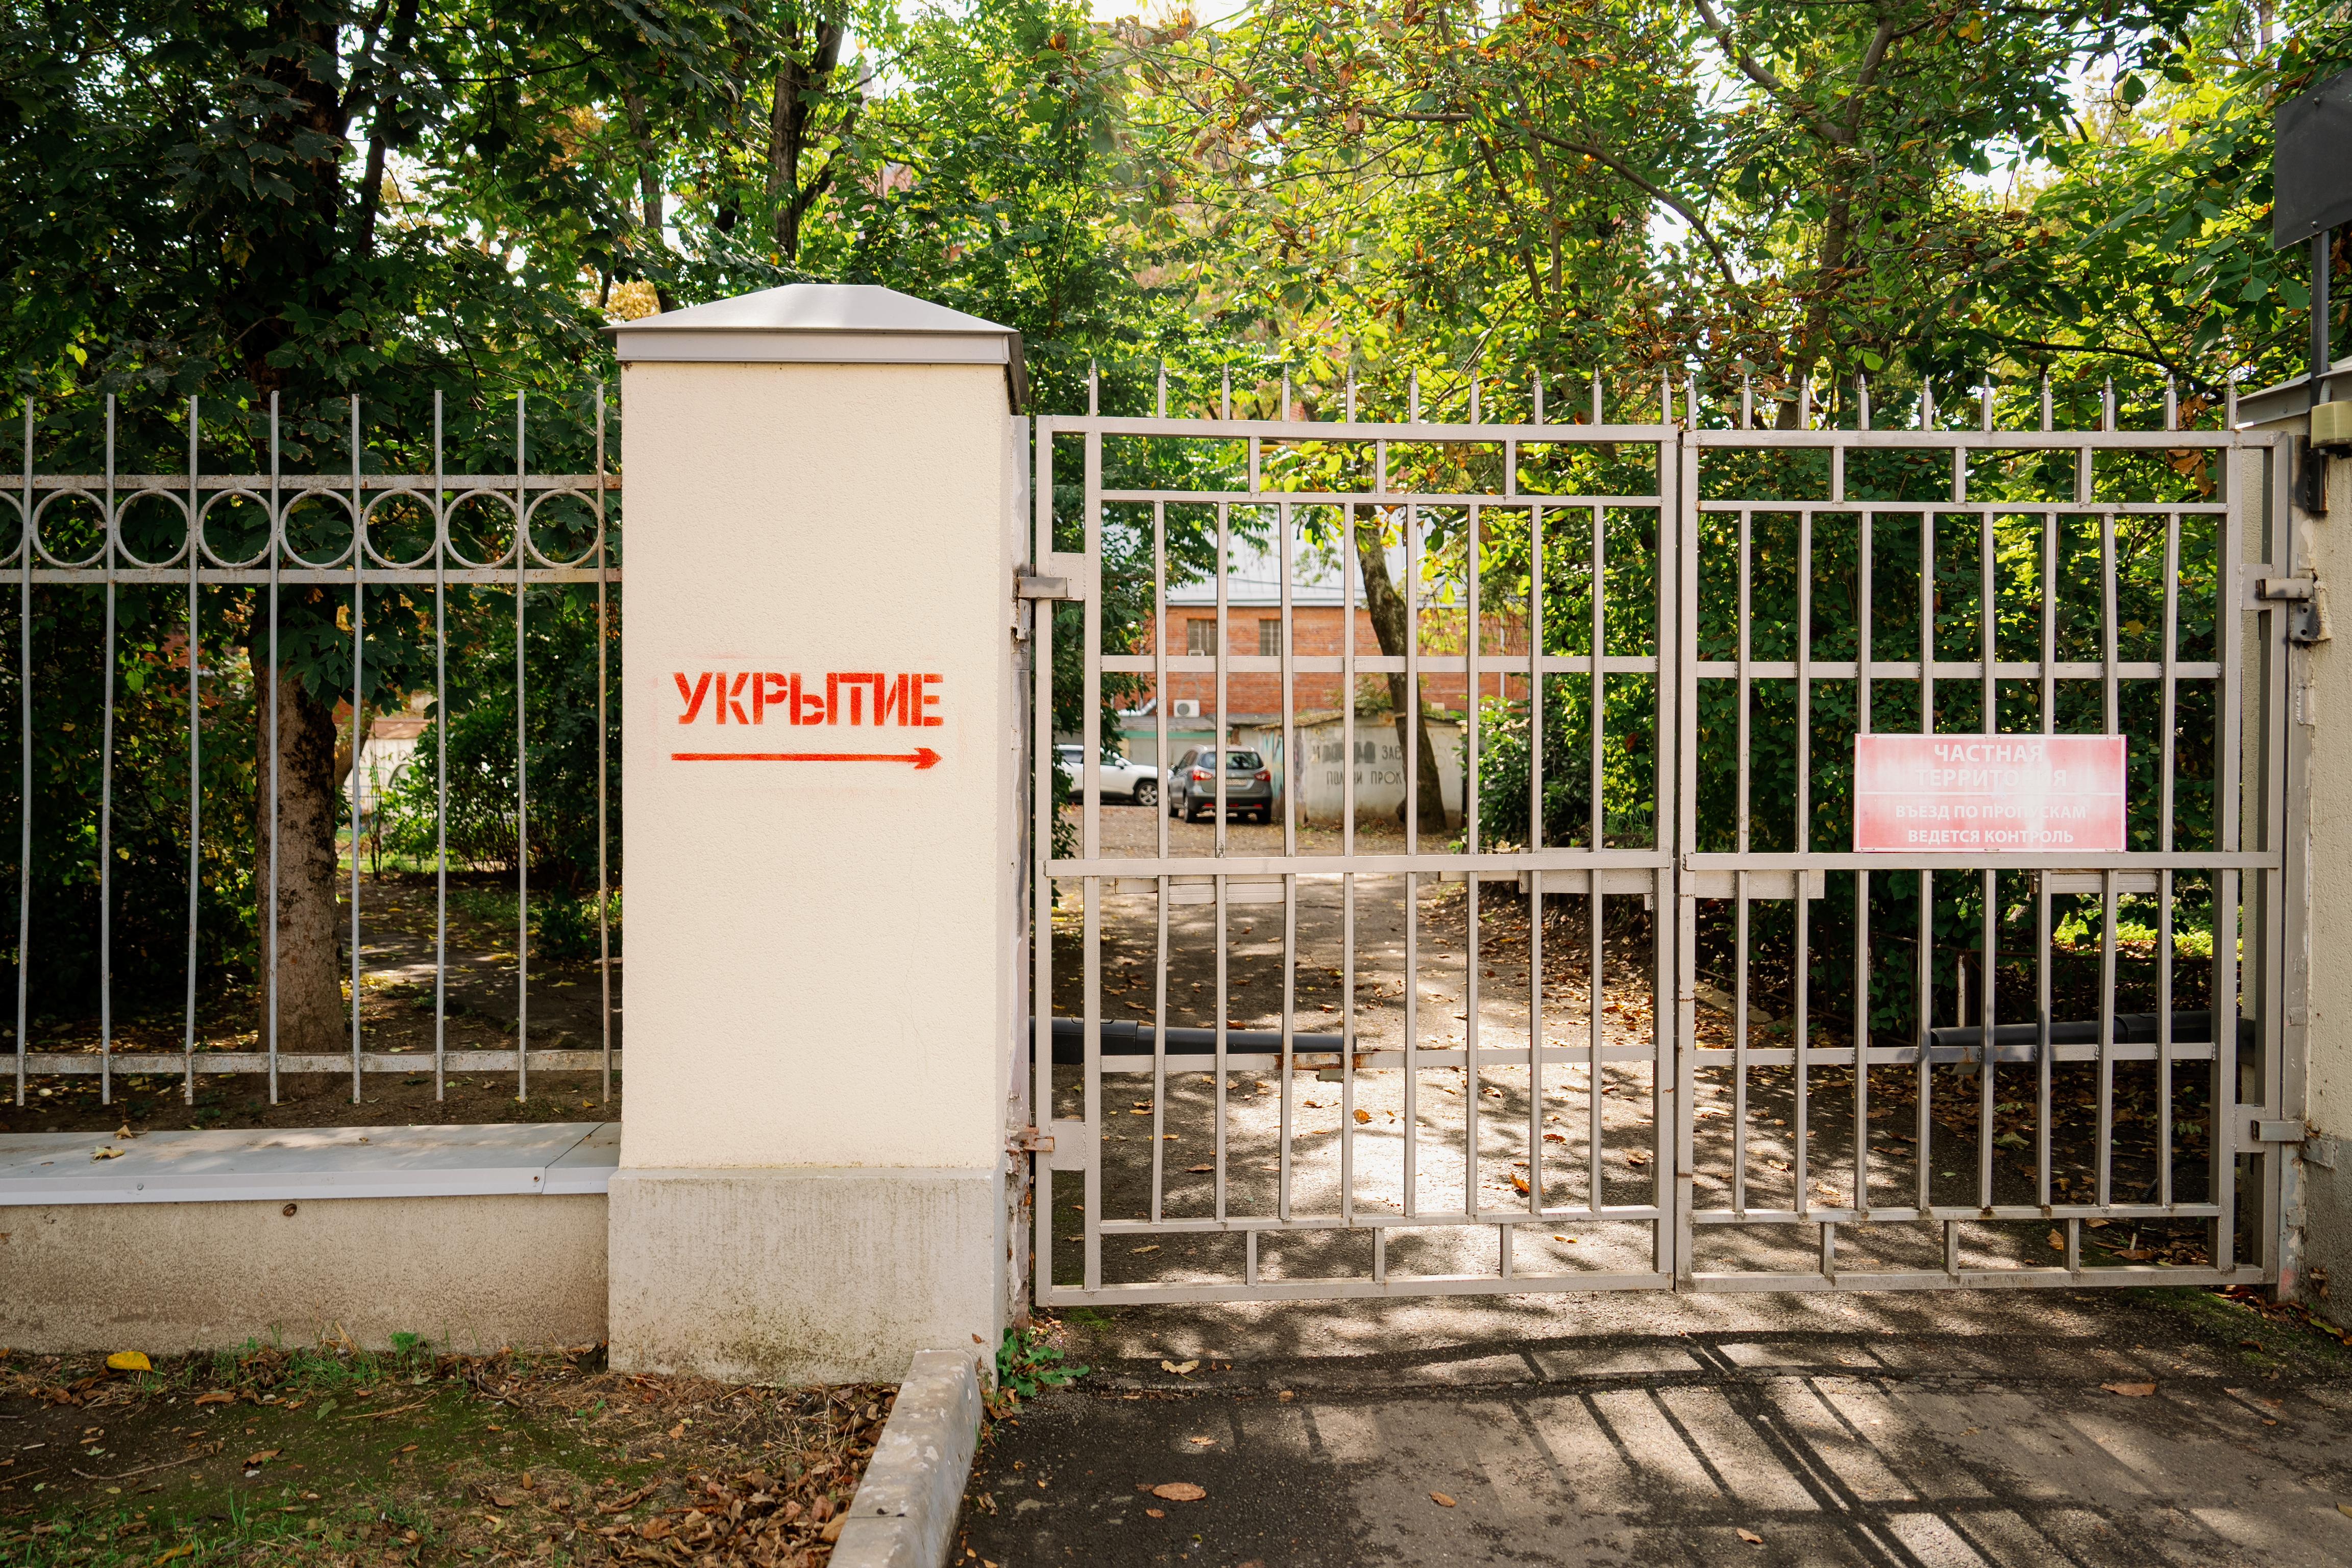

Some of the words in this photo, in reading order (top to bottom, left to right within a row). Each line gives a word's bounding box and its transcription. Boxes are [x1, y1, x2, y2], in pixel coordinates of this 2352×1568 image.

[672, 672, 944, 726] УКРЫТИЕ
[1934, 744, 2042, 762] ЧАСТНАЯ
[1370, 770, 1402, 785] ПРОК
[1896, 805, 1949, 820] ВЪЕЗД
[1954, 805, 1978, 818] ПО
[1982, 805, 2087, 819] ПРОПУСКАМ
[1908, 829, 1980, 845] ВЕДЕТСЯ
[1985, 829, 2074, 844] КОНТРОЛЬ
